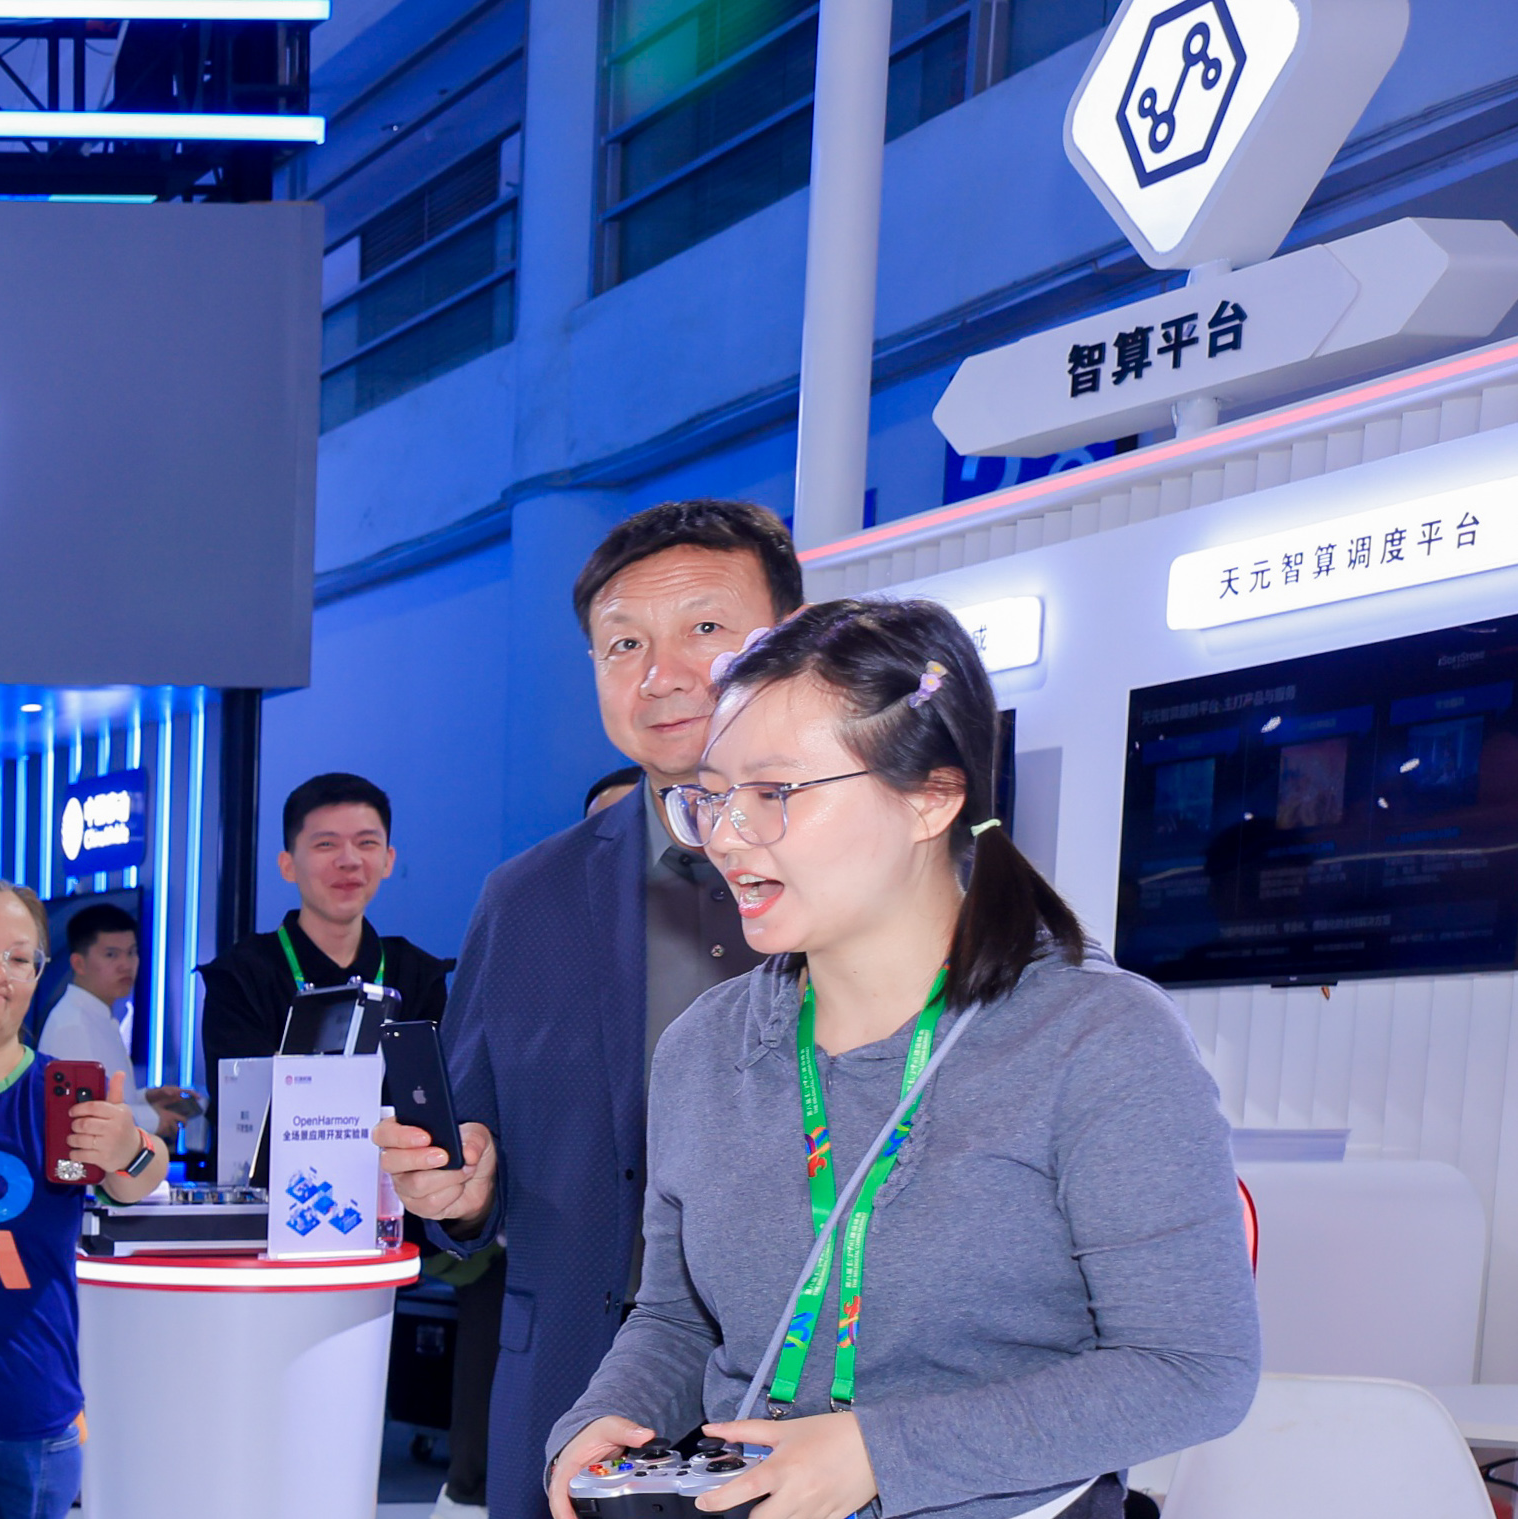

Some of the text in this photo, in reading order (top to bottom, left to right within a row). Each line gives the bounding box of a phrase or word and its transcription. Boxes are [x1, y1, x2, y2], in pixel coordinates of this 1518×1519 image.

[1067, 300, 1248, 398] 智算平台
[1219, 512, 1481, 600] 天元智算调度平台
[292, 1115, 360, 1128] OpenHarmony
